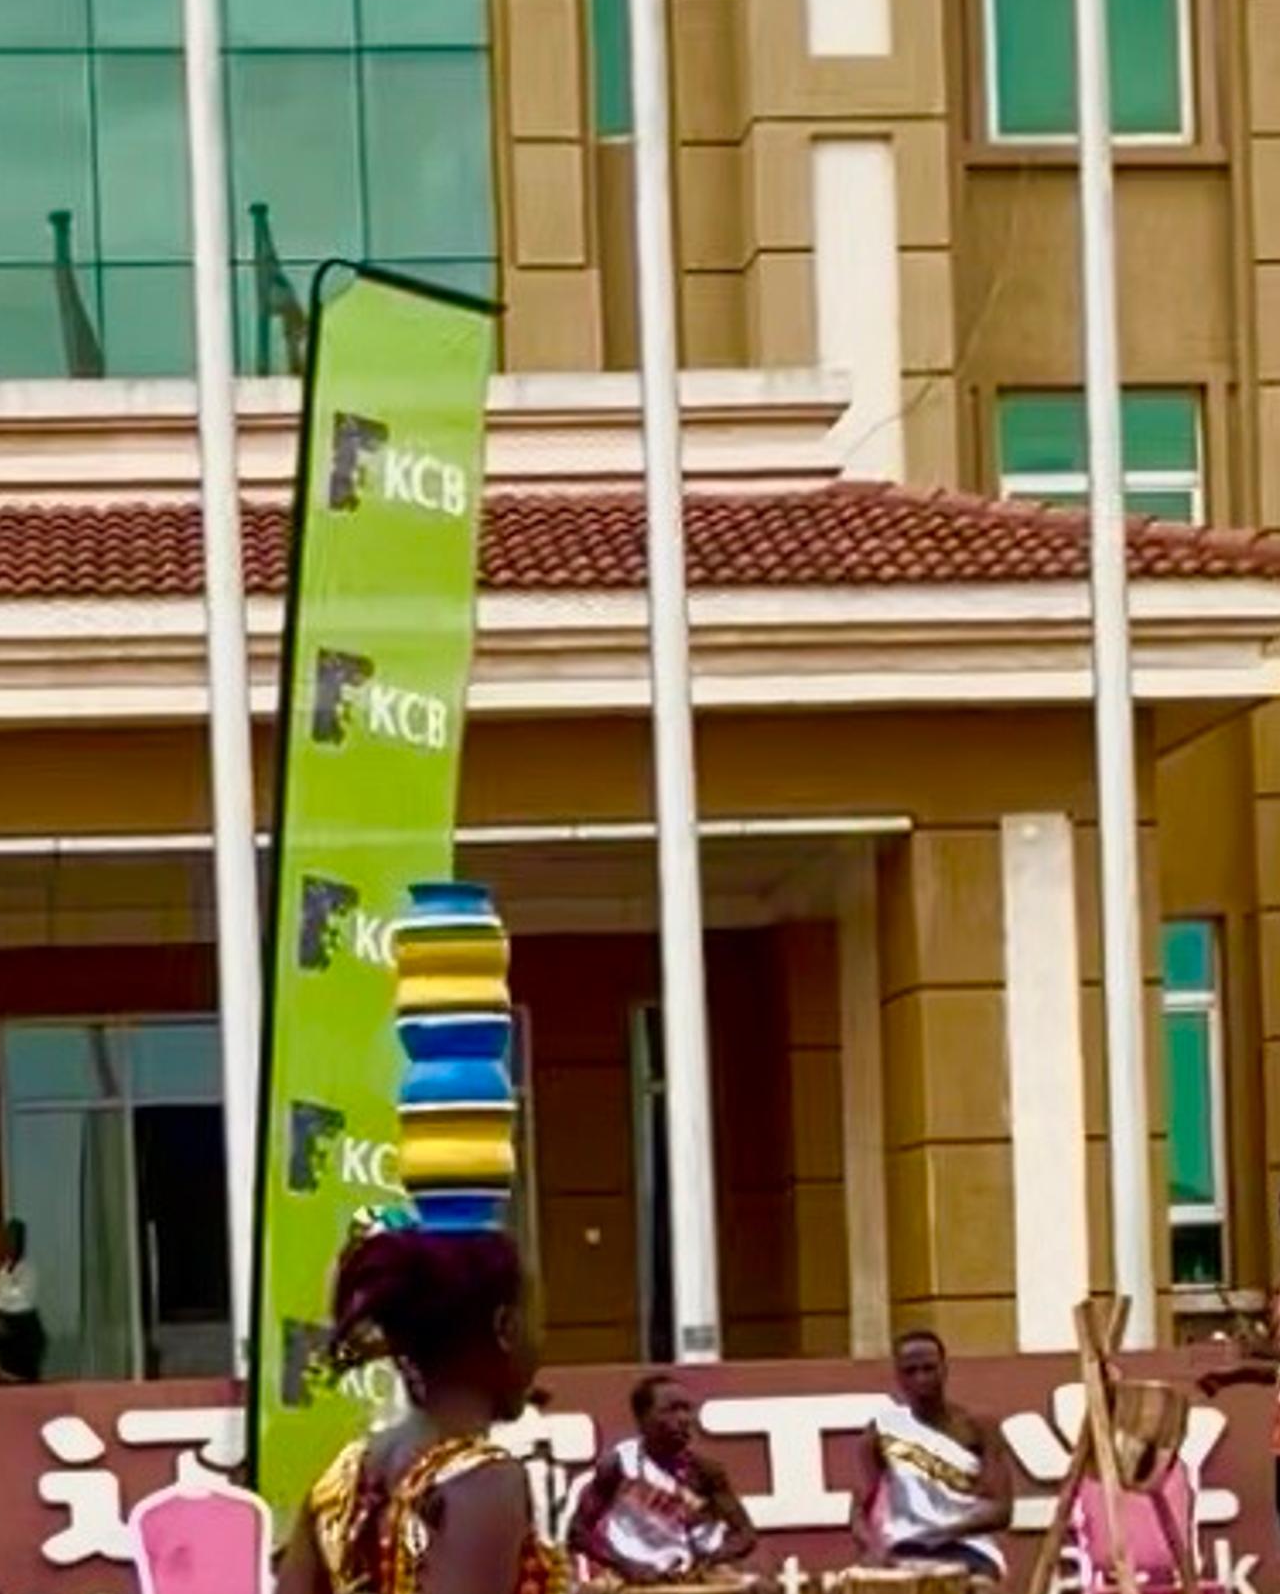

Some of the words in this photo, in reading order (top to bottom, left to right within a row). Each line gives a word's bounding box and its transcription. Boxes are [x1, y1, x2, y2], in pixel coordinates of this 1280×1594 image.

[382, 448, 467, 515] KCB
[368, 684, 447, 746] KCB
[354, 912, 401, 968] KC
[341, 1137, 406, 1195] KC
